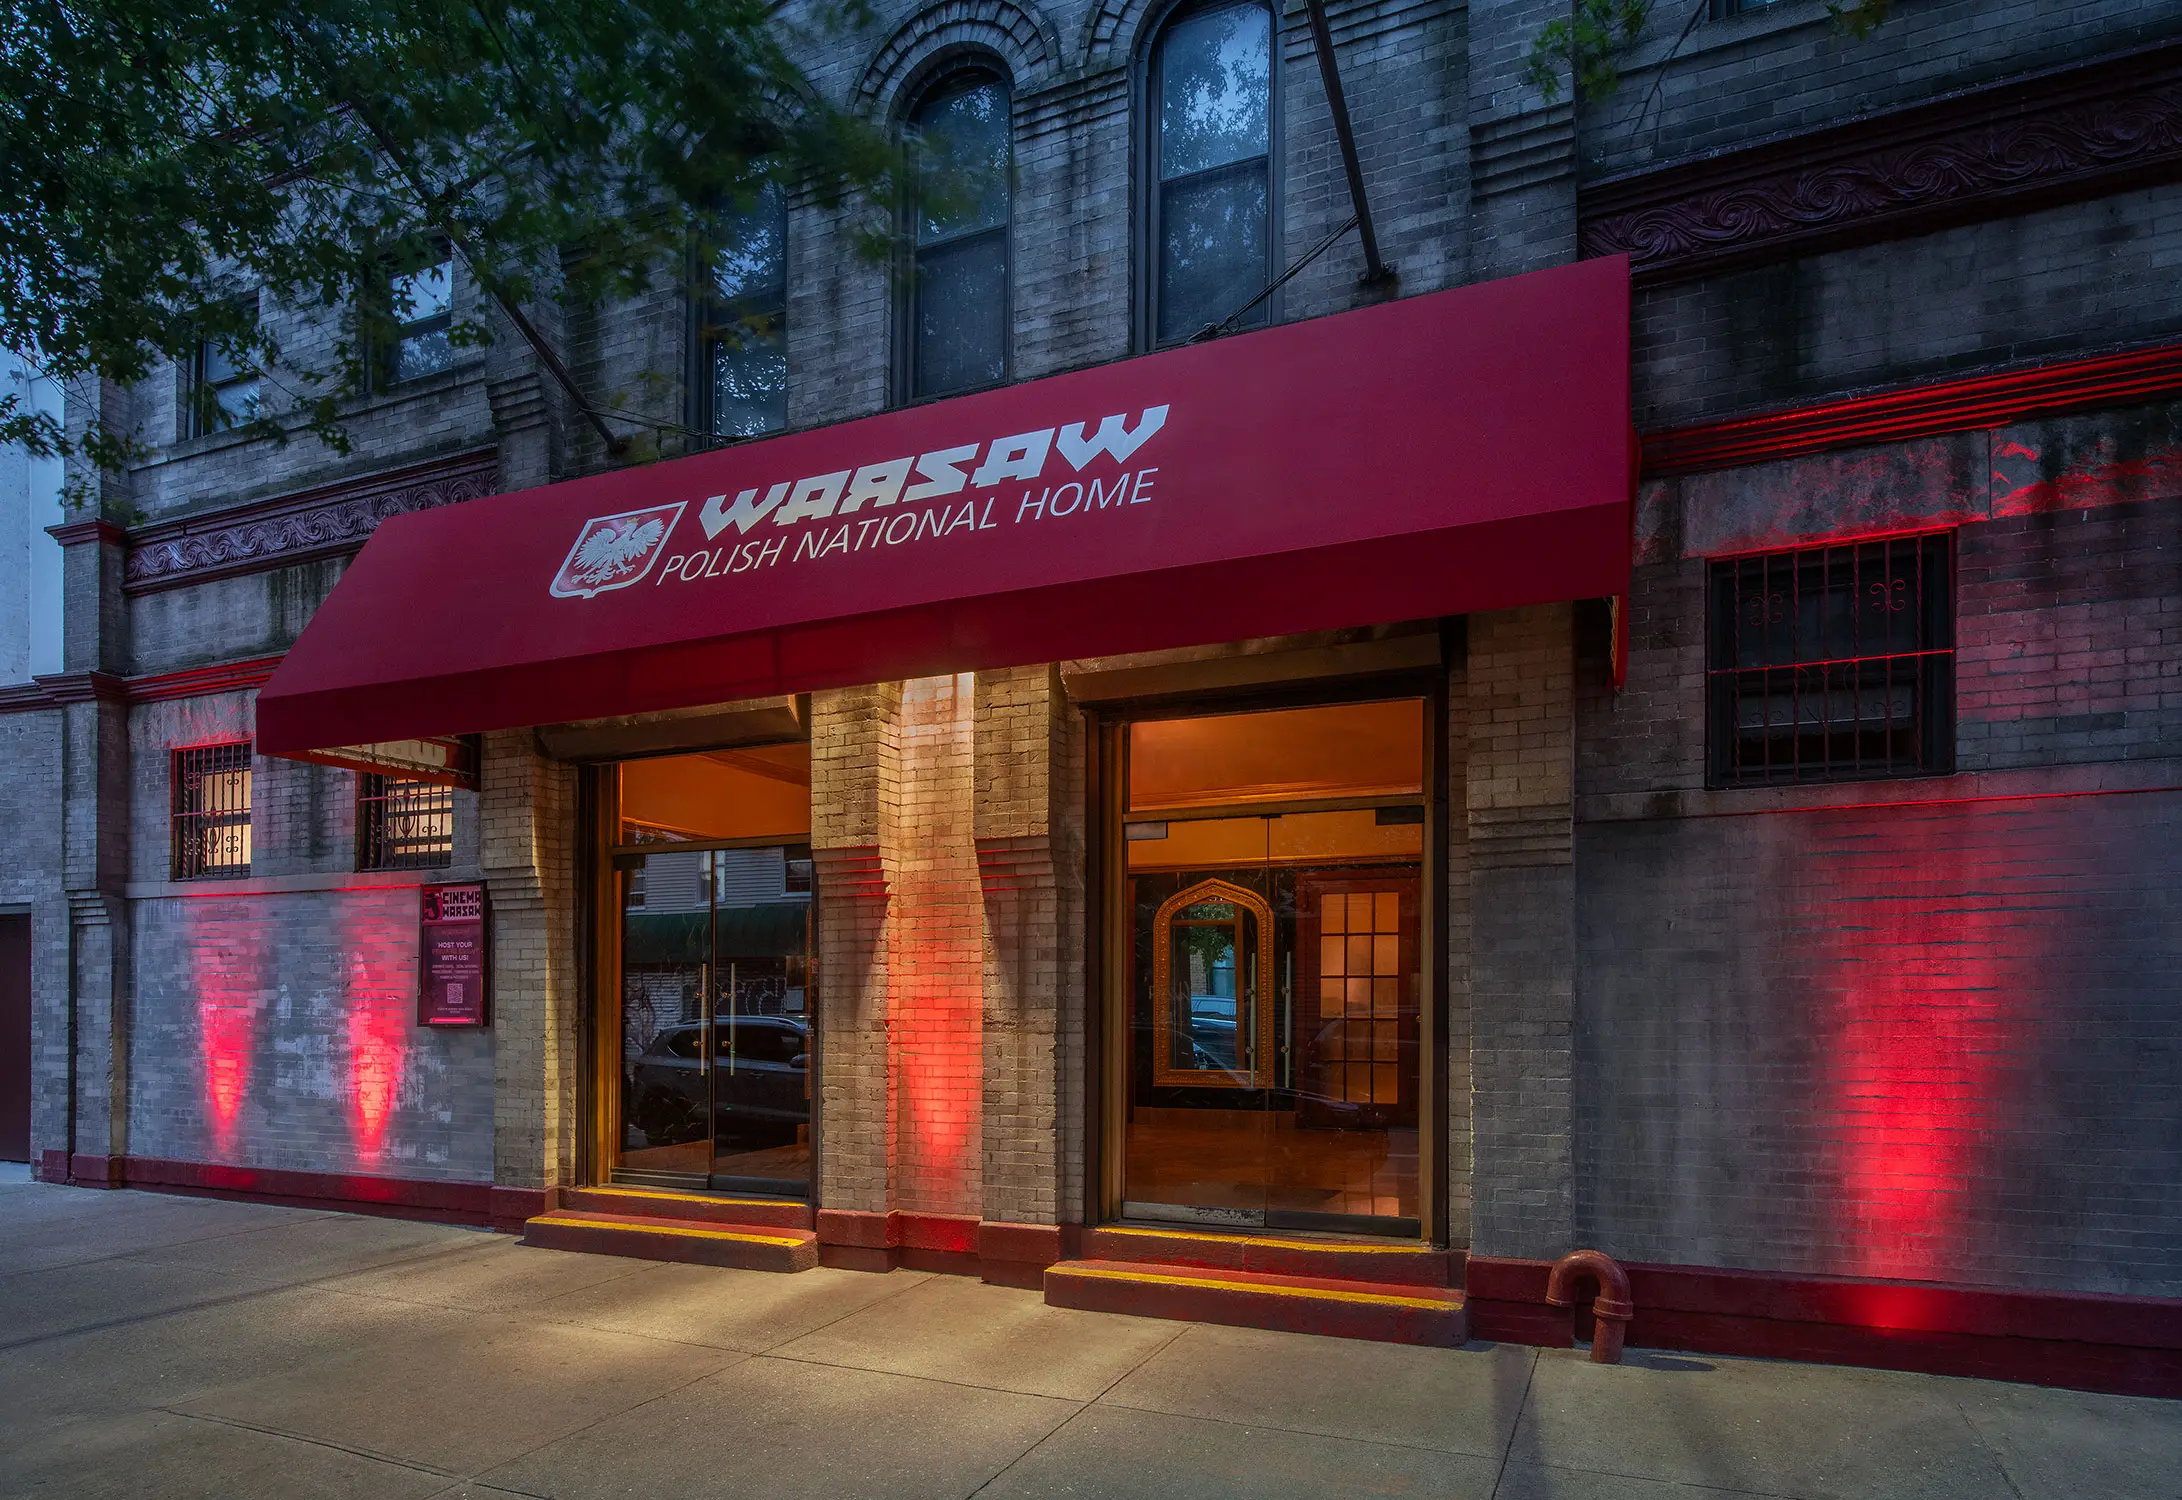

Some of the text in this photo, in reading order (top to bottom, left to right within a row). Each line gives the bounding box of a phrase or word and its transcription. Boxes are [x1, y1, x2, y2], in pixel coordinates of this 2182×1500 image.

[699, 404, 1170, 541] WARSAW
[656, 467, 1159, 585] POLISH NATIONAL HOME
[442, 891, 481, 905] CINEMA
[442, 904, 481, 918] WARSAW
[437, 941, 455, 949] HOST
